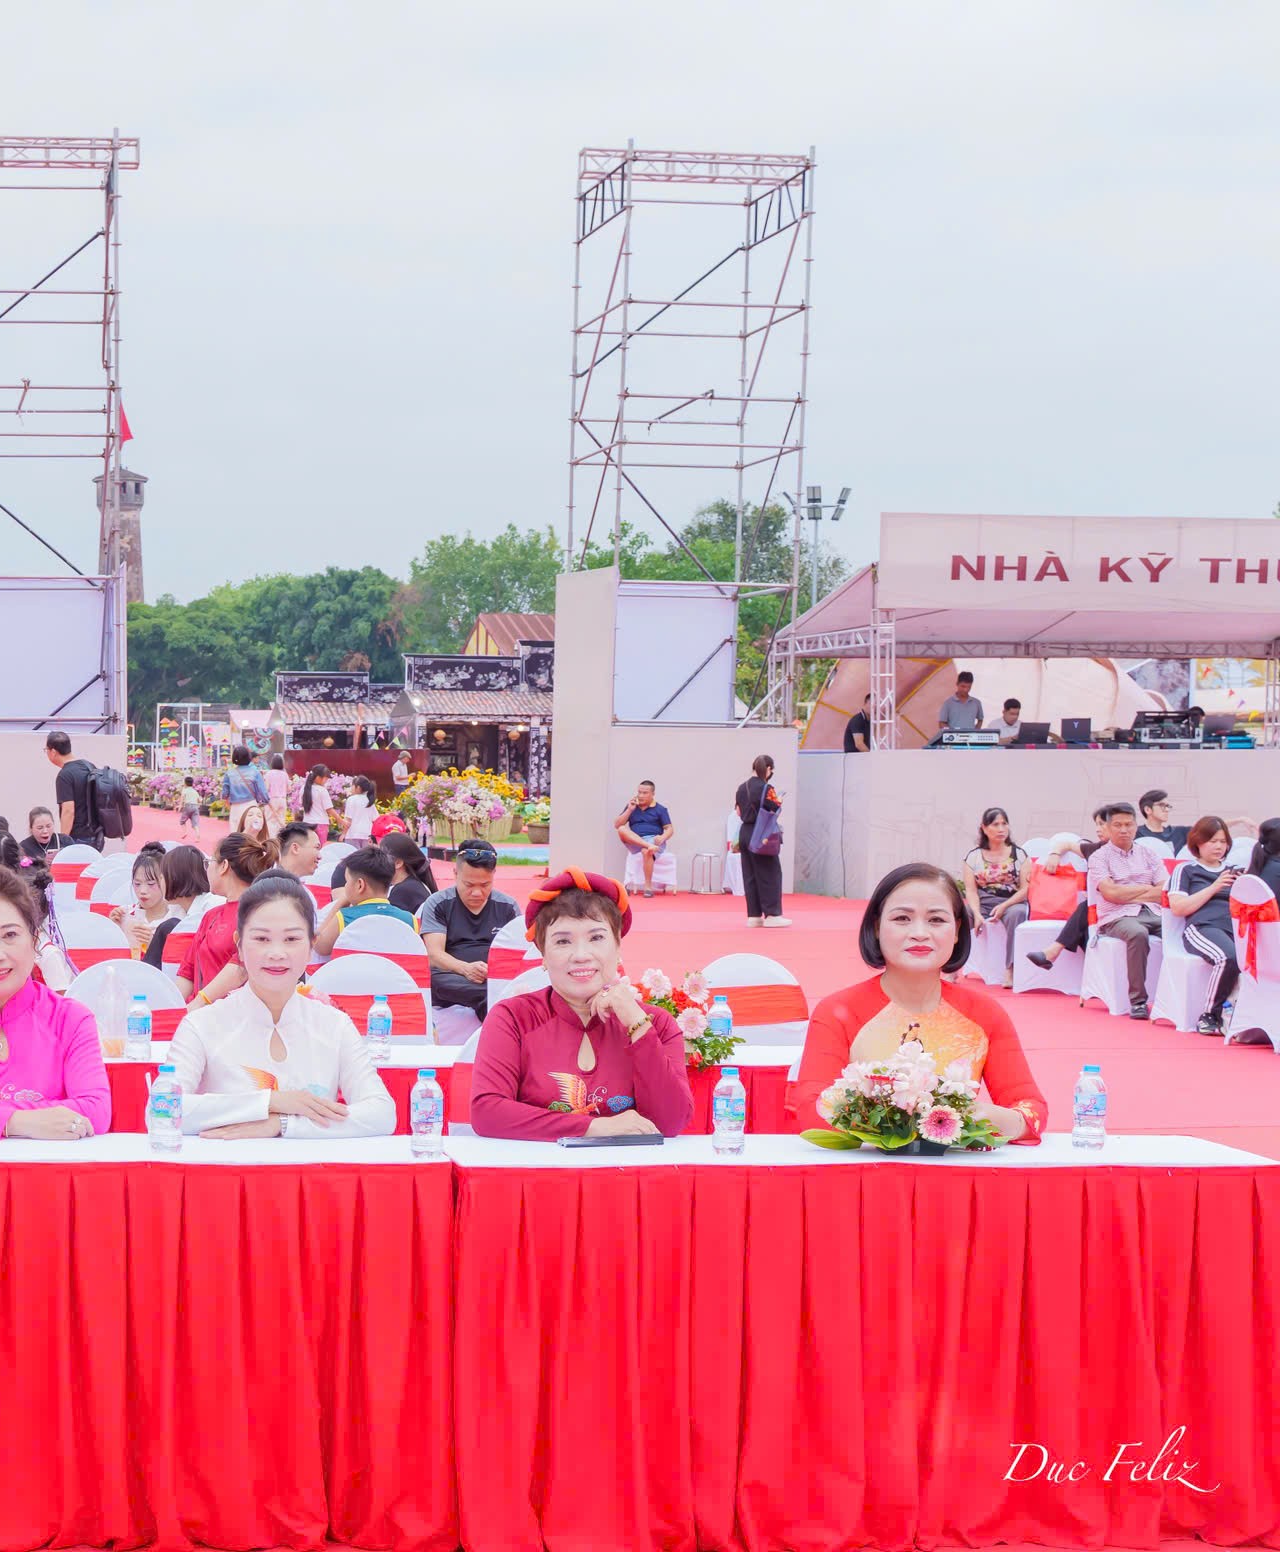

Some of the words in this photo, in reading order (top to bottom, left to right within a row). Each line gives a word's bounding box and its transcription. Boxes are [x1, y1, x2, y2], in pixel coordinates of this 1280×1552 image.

[951, 550, 1070, 582] NHÀ
[1099, 552, 1174, 583] KỸ
[1199, 558, 1280, 585] TH
